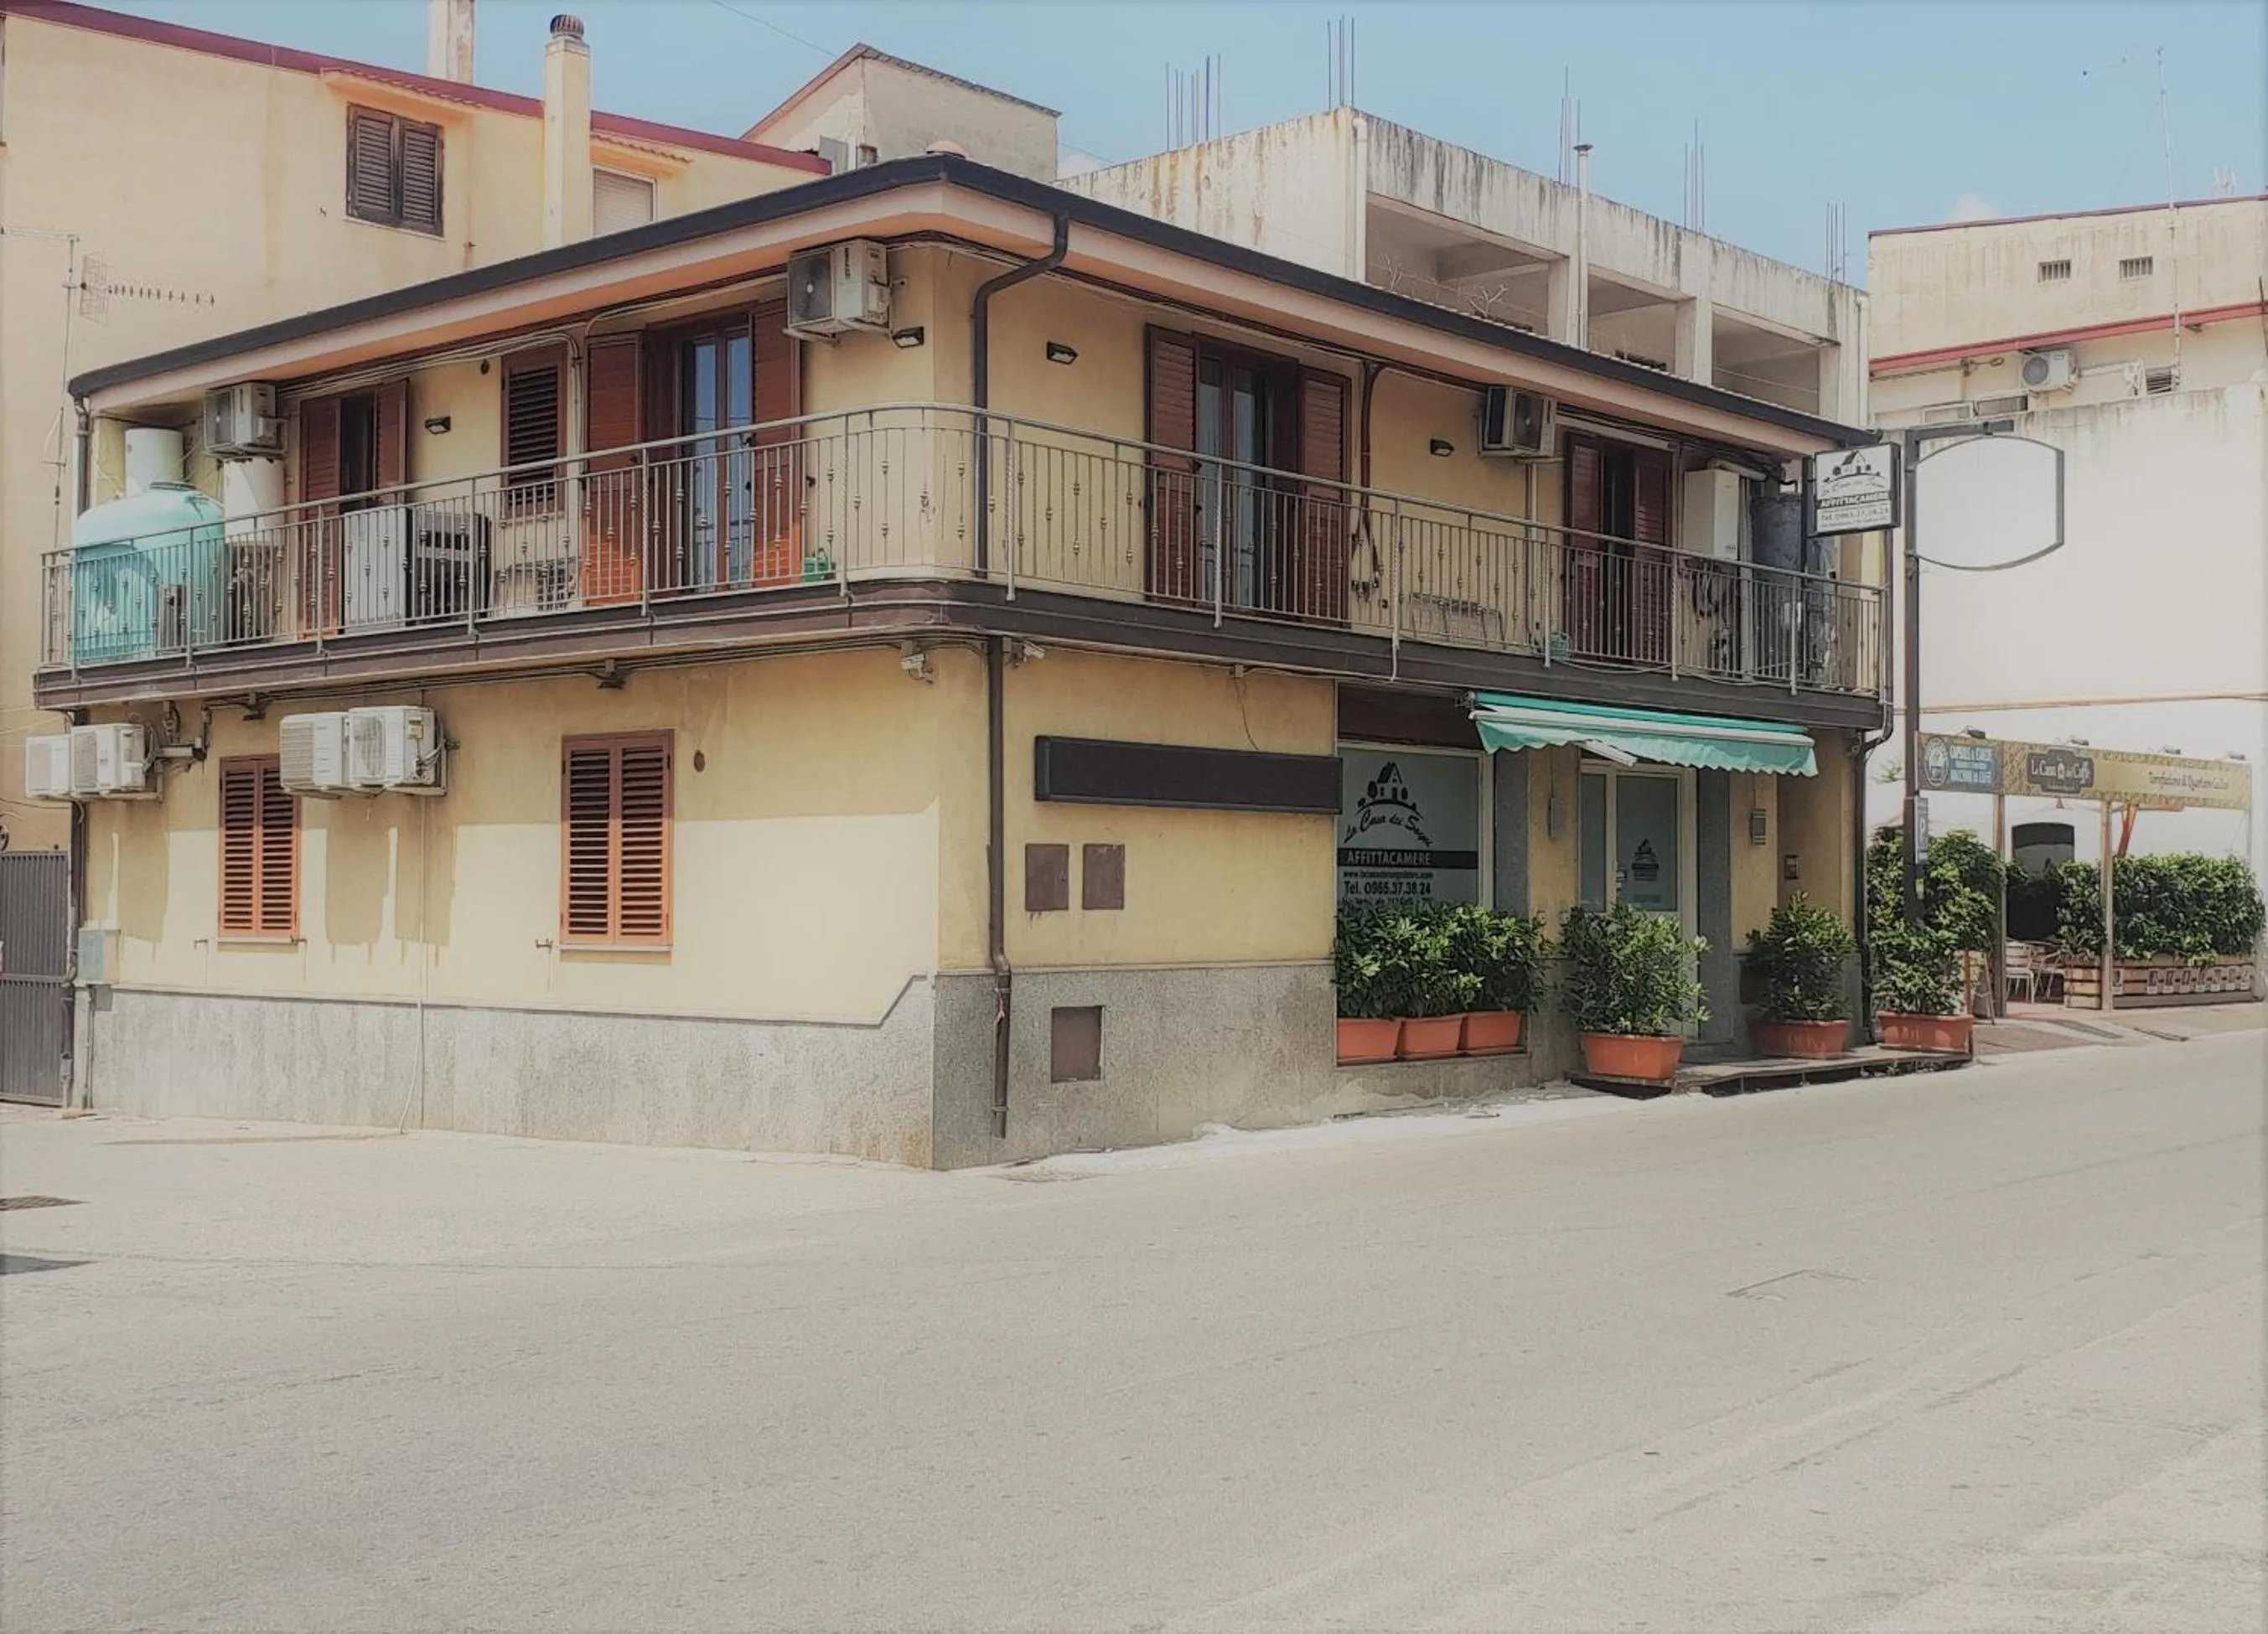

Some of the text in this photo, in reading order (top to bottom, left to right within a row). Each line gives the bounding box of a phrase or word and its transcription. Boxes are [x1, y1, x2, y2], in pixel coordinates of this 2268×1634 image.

[1360, 809, 1386, 832] Casa
[1346, 850, 1432, 866] AFFITTACAMERE
[1344, 881, 1361, 896] Tel.
